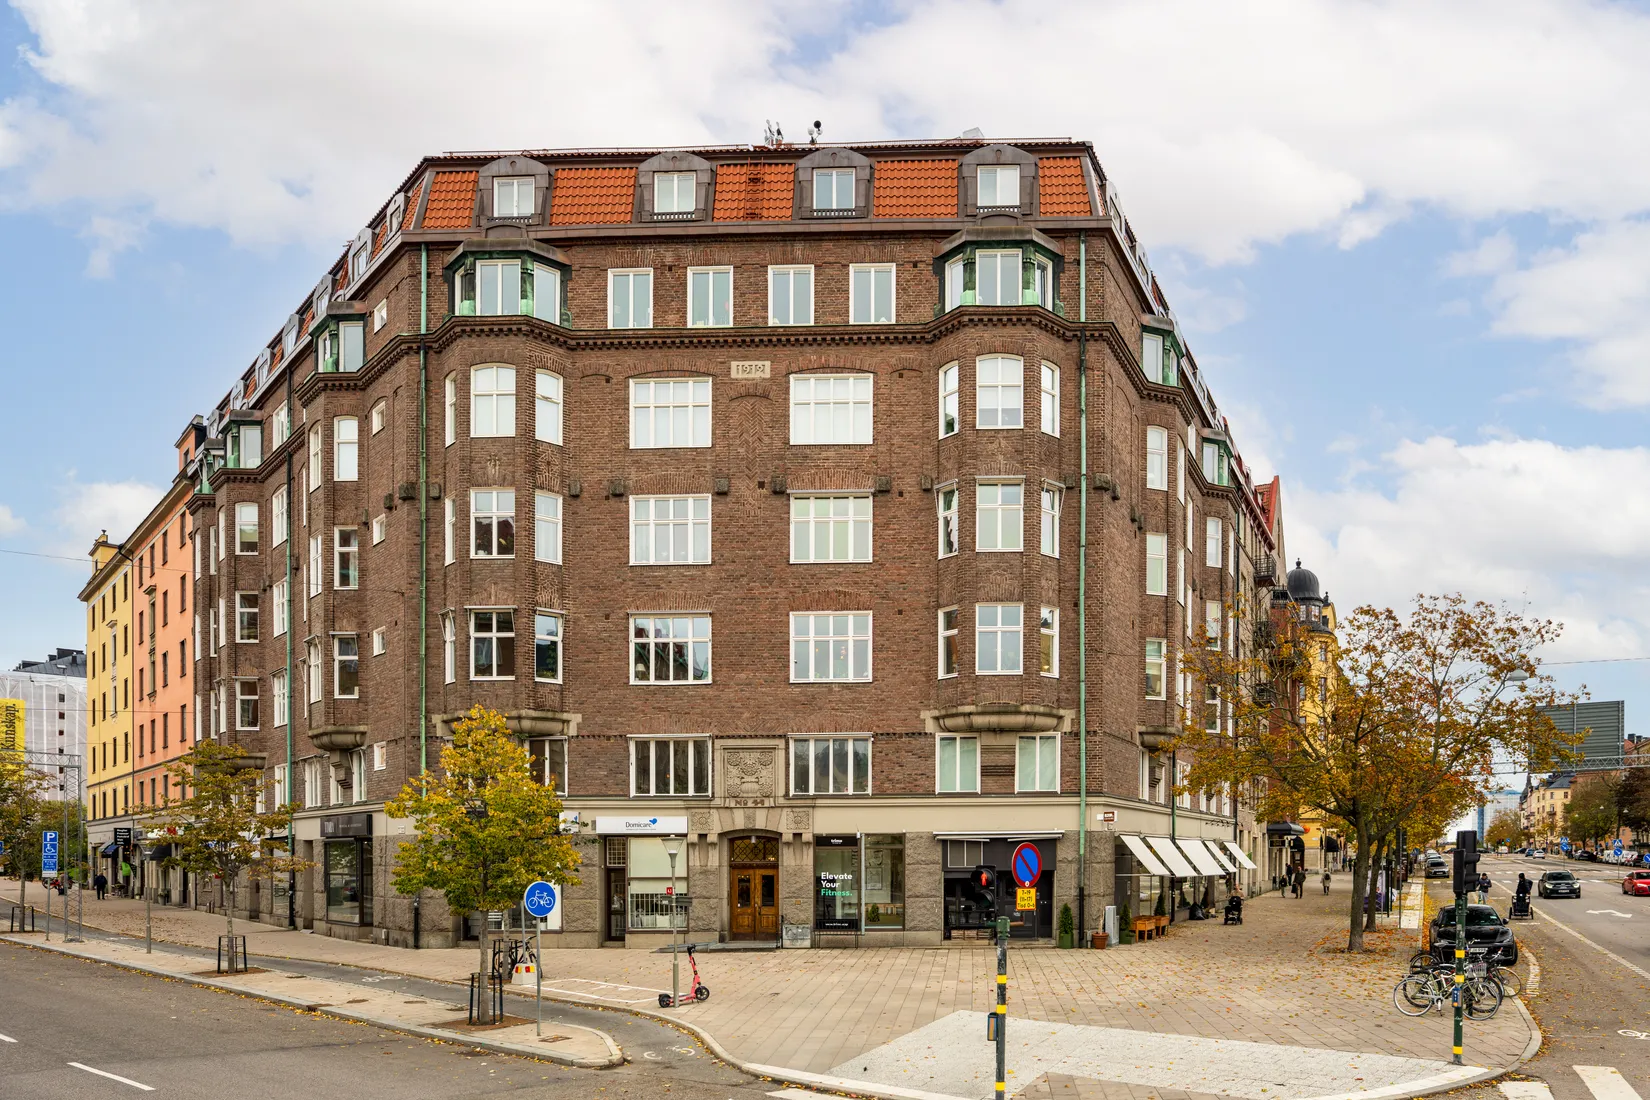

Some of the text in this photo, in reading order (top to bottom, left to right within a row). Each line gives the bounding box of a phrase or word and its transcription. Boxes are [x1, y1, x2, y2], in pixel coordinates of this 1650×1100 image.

[736, 364, 766, 375] 1919
[1, 703, 19, 750] Kunskap.
[46, 832, 55, 842] P
[821, 872, 853, 880] Elevate
[821, 880, 840, 888] Your
[821, 888, 853, 896] Fitness.
